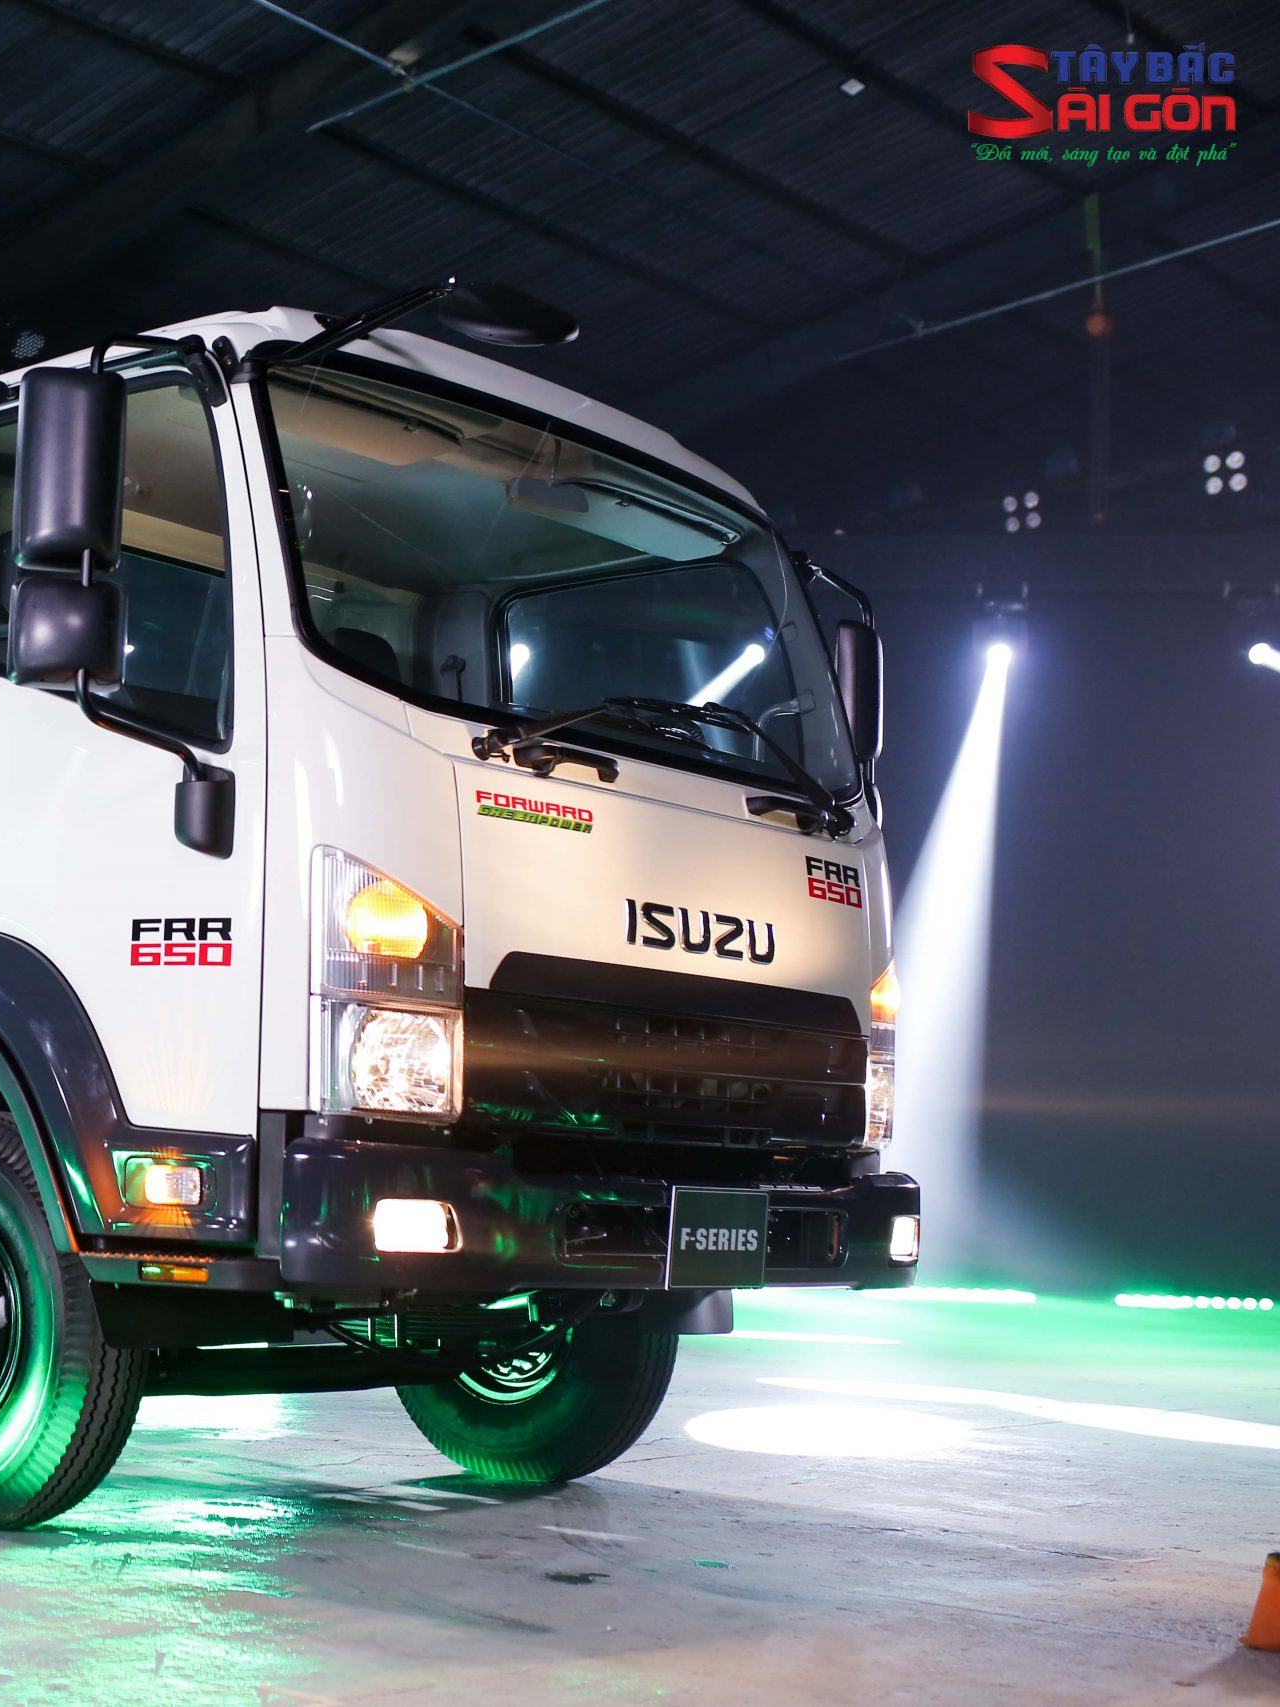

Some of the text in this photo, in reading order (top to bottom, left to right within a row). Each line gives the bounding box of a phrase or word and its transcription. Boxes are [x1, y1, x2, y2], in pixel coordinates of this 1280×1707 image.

[475, 790, 593, 823] FORWARD
[805, 855, 860, 888] FRR
[807, 876, 862, 909] 650
[131, 917, 232, 942] FRR
[624, 898, 775, 965] ISUZU
[130, 943, 232, 967] 650
[680, 1227, 759, 1252] F-SERIES
